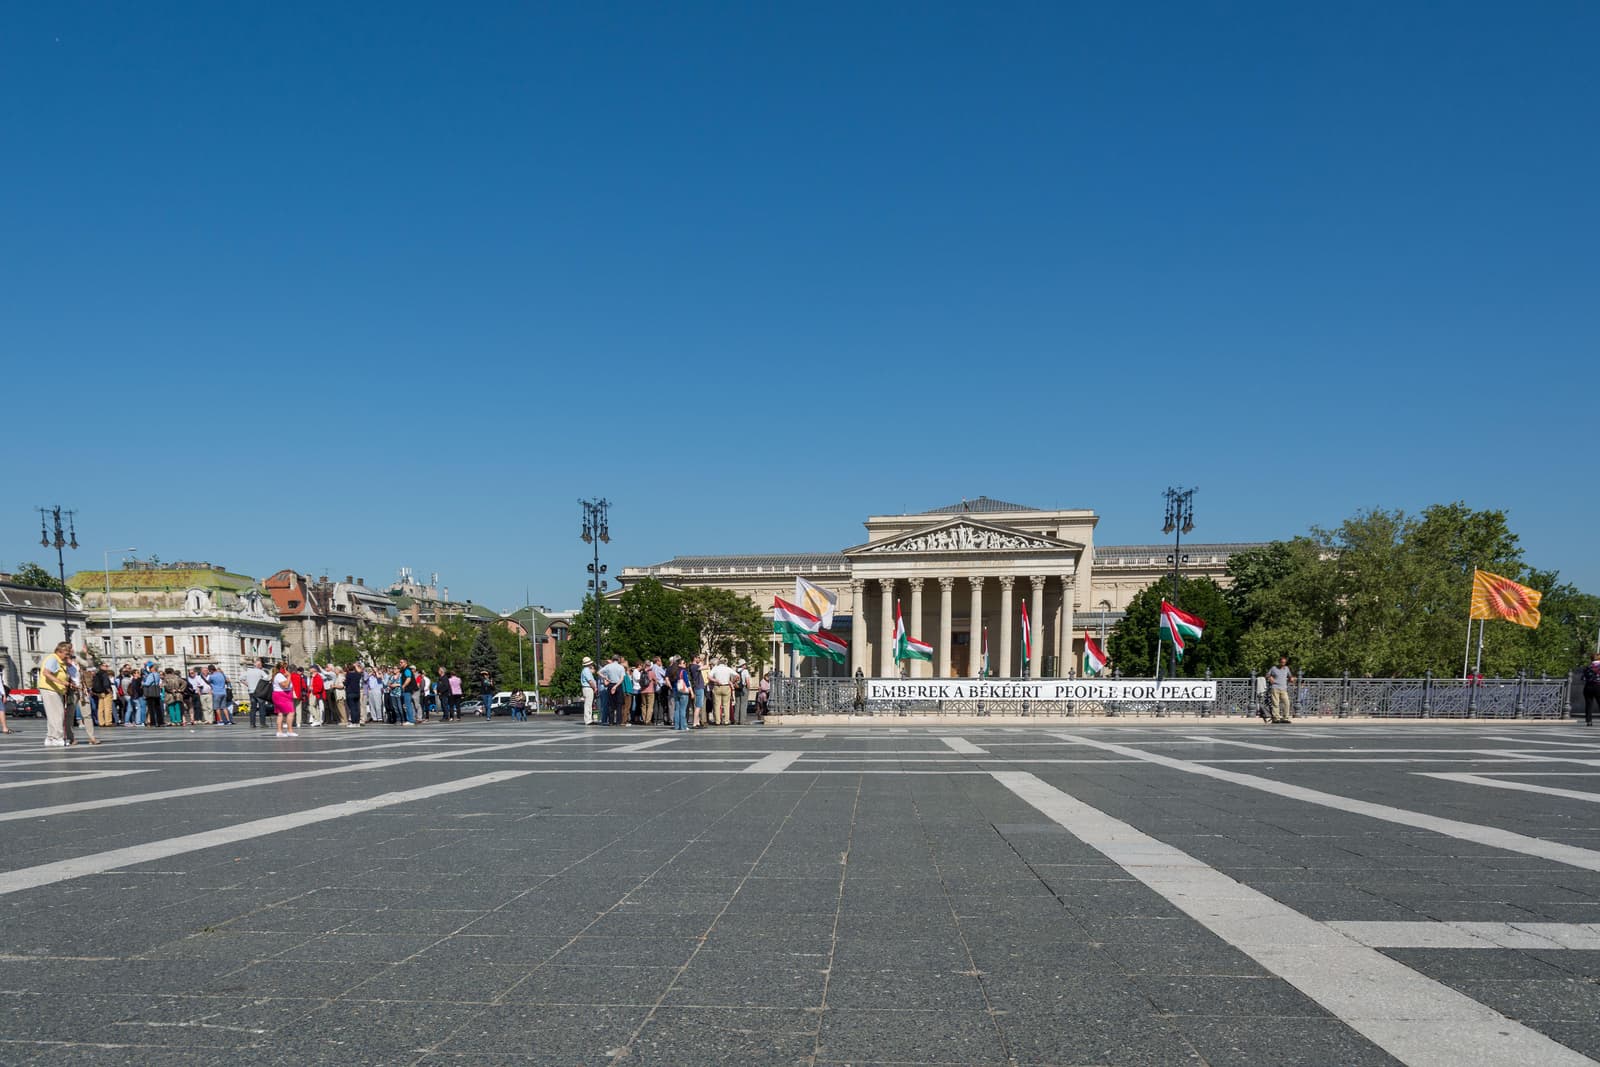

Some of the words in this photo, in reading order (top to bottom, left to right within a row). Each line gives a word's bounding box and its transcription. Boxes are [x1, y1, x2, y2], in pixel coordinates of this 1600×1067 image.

[872, 685, 951, 698] EMBEREK
[954, 686, 964, 698] A
[969, 683, 1042, 698] BÉKÉÉRT
[1055, 686, 1118, 698] PEOPLE
[1123, 686, 1156, 698] FOR
[1161, 686, 1213, 699] PEACE
